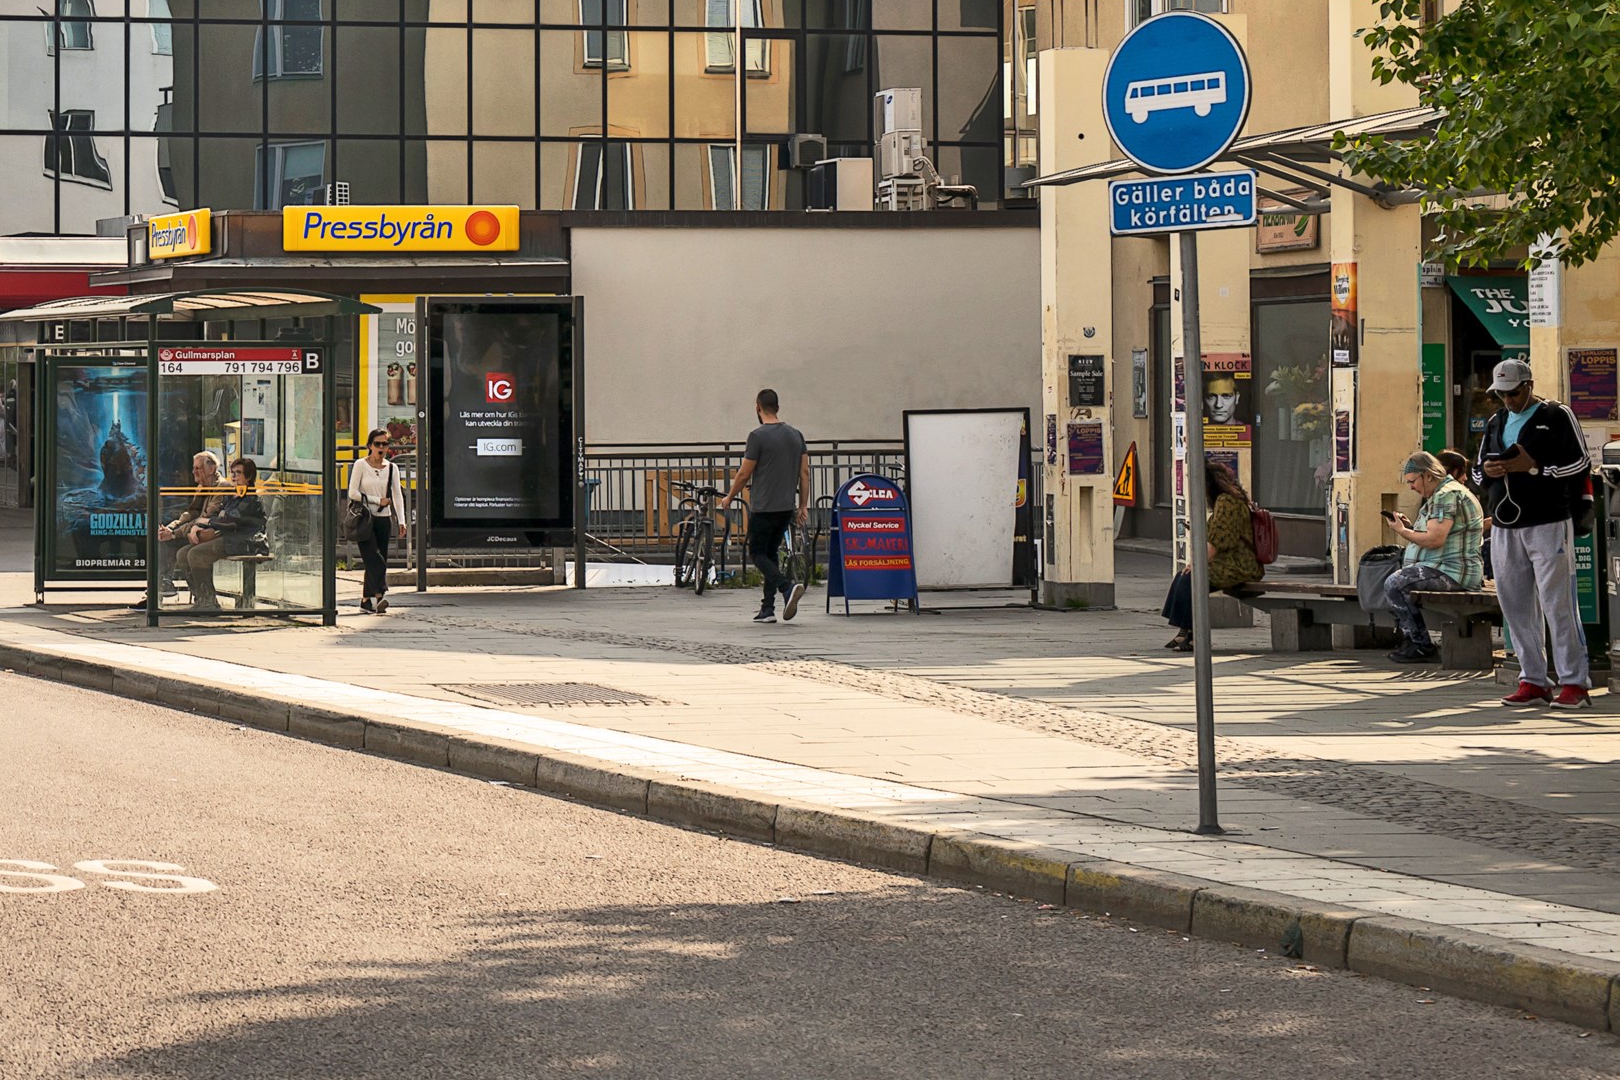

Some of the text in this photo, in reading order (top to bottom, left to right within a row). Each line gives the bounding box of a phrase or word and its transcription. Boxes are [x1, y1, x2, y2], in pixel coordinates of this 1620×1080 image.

[1115, 178, 1250, 205] Gäller båda
[1131, 204, 1235, 226] körfälten
[151, 217, 186, 252] Pressbyrån
[304, 212, 453, 246] Pressbyrån
[1470, 288, 1515, 299] THE
[1485, 300, 1529, 314] JU
[396, 317, 416, 335] Mö
[1508, 318, 1530, 327] YO
[396, 341, 416, 357] go
[175, 350, 235, 361] Gullmarsplan
[306, 353, 319, 369] B
[1581, 356, 1616, 365] LOPPIS
[161, 362, 300, 373] 164 791 794 796
[1214, 360, 1247, 370] KLOCK
[1070, 370, 1091, 378] Sample
[488, 380, 512, 399] IG
[484, 442, 516, 452] IG.com
[90, 513, 142, 529] GODZILLA
[847, 521, 899, 529] Nyckel Service
[76, 559, 146, 567] BIOPREMIÄR 29
